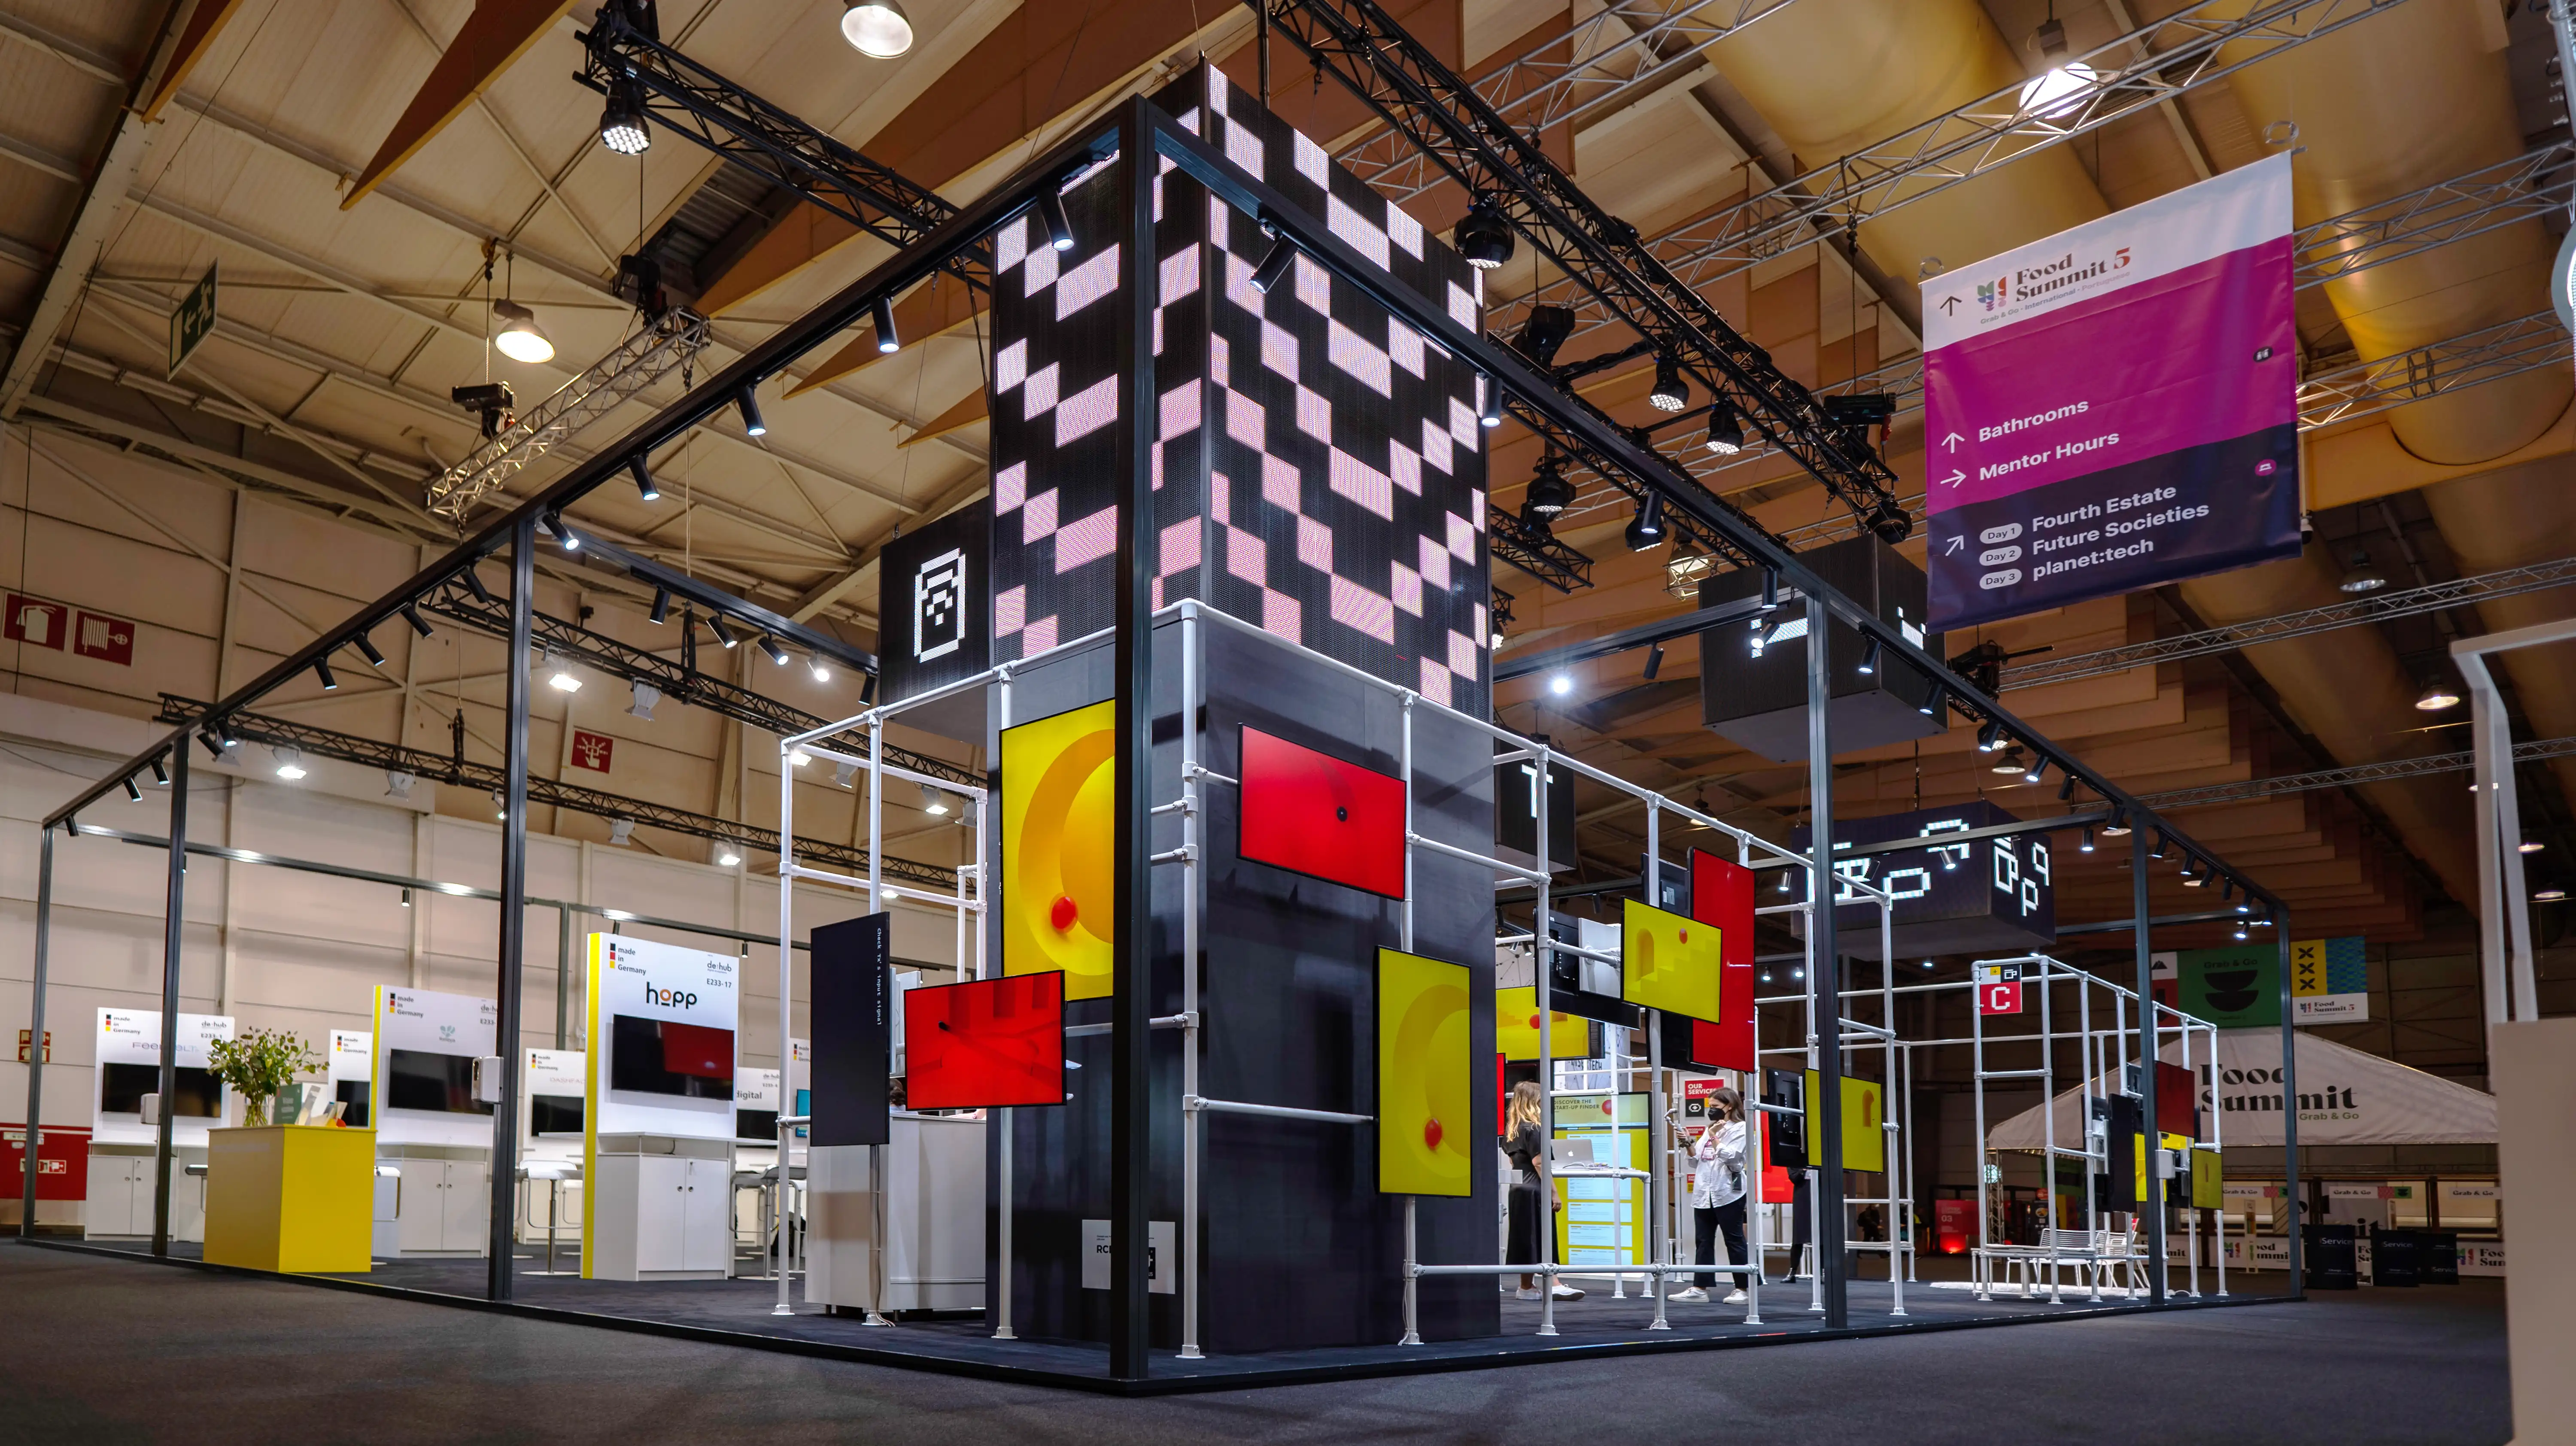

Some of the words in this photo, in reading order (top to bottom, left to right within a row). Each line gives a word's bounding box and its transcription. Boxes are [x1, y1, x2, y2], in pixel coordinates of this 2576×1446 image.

[2016, 253, 2072, 286] Food
[2016, 260, 2108, 302] Summit
[2114, 247, 2131, 270] 5
[1980, 315, 1999, 324] Grab
[2008, 307, 2019, 316] Go
[2025, 289, 2075, 310] International
[2082, 271, 2130, 292] Portuguese
[1979, 401, 2089, 442] Bathrooms
[1980, 451, 2051, 480] Mentor
[2056, 433, 2120, 459] Hours
[1988, 531, 2008, 541] Day
[2032, 504, 2101, 532] Fourth
[2106, 486, 2176, 513] Estate
[1986, 553, 2008, 563] Day
[2033, 529, 2100, 555] Future
[2105, 504, 2209, 537] Societies
[1986, 577, 2006, 586] Day
[2033, 539, 2154, 581] planet:tech
[618, 947, 636, 956] made
[618, 964, 647, 976] Germany
[646, 981, 697, 1009] hopp
[1991, 987, 2011, 1010] C
[397, 1009, 424, 1018] Germany
[2201, 1085, 2358, 1112] Summit
[1097, 1245, 1111, 1253] RC
